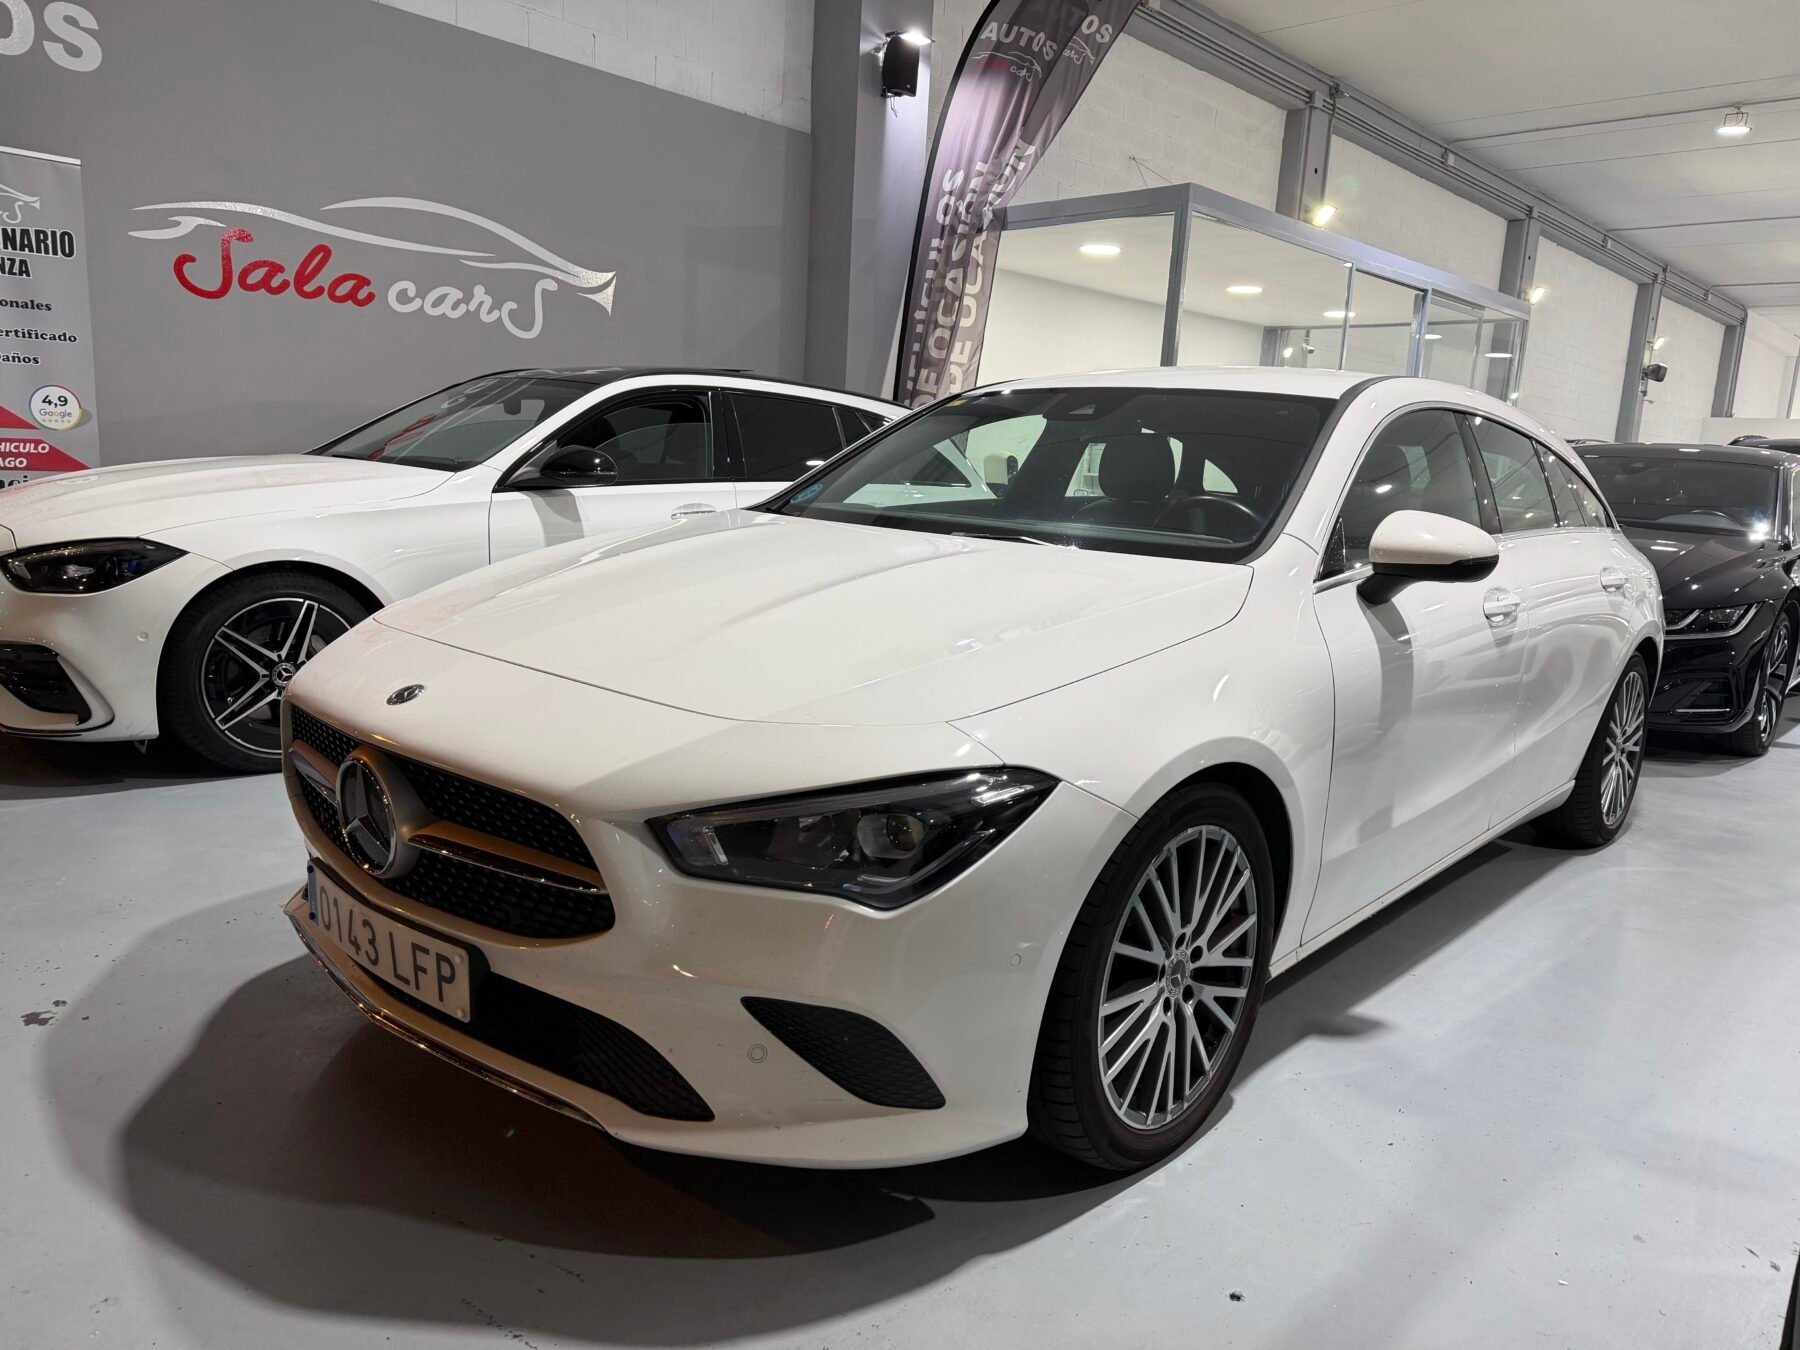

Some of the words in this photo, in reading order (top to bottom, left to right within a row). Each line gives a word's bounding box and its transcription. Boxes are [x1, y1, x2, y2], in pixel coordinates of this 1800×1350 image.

[980, 21, 1058, 61] AUTOS
[0, 352, 40, 365] años
[41, 394, 68, 408] 4,9
[38, 408, 73, 418] Google
[319, 885, 379, 967] 0143
[389, 931, 456, 1002] LFP
